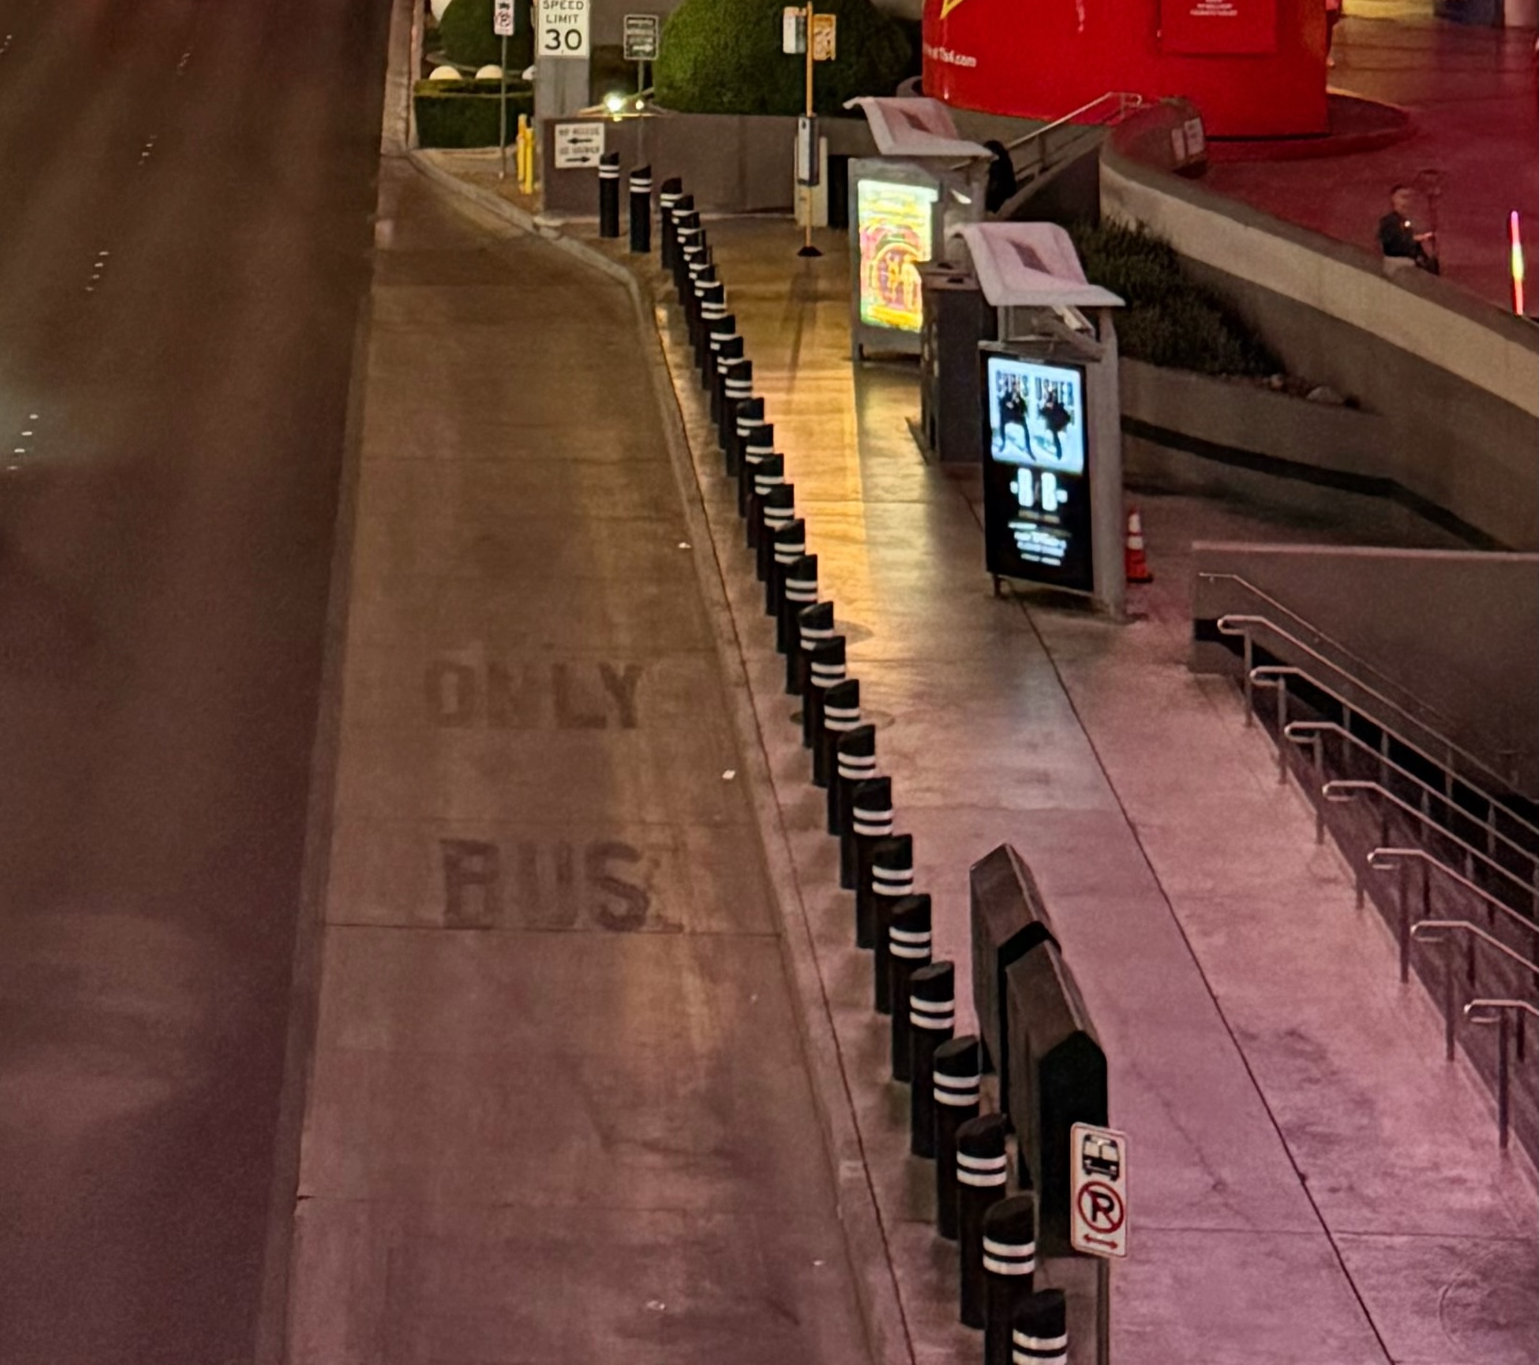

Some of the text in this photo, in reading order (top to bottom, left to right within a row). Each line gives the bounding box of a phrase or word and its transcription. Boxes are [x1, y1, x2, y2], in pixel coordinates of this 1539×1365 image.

[542, 0, 585, 11] SPEED
[546, 14, 580, 24] LIMIT
[544, 28, 583, 51] 30
[424, 660, 648, 730] ONLY
[439, 838, 653, 933] BUS
